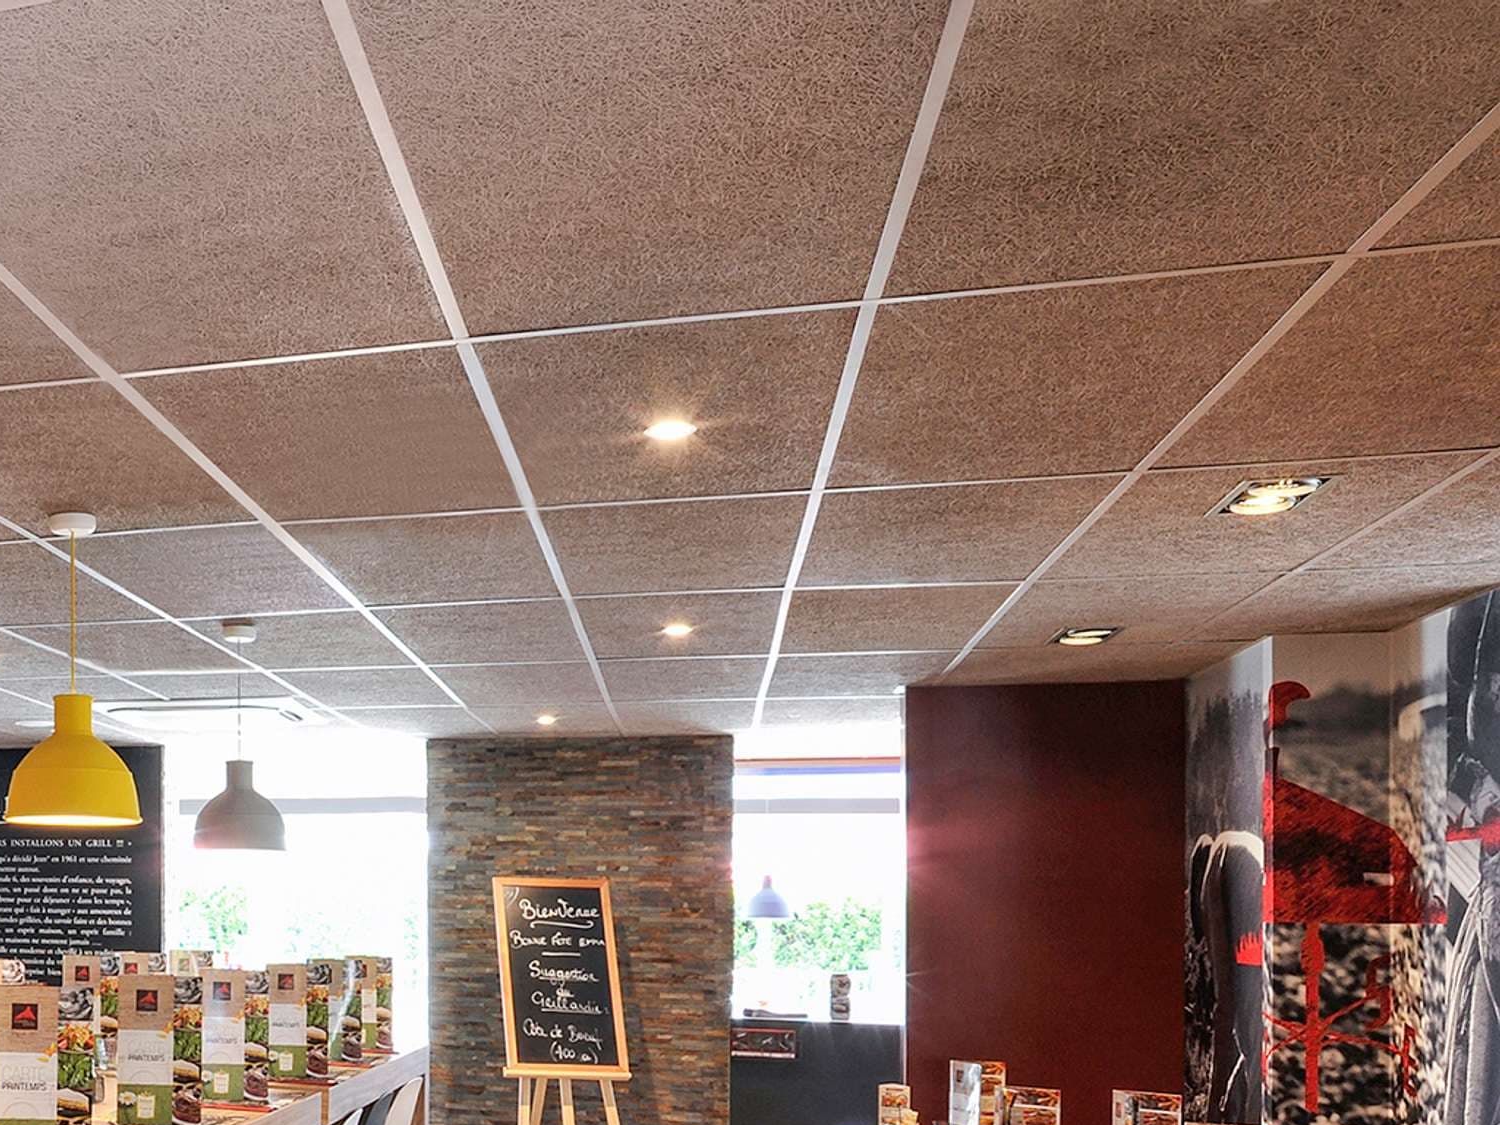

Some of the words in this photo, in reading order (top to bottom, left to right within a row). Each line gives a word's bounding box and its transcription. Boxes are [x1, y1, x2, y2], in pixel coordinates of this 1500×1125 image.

[10, 839, 65, 848] INSTALLONS
[68, 839, 82, 848] UN
[85, 839, 113, 848] GRILL
